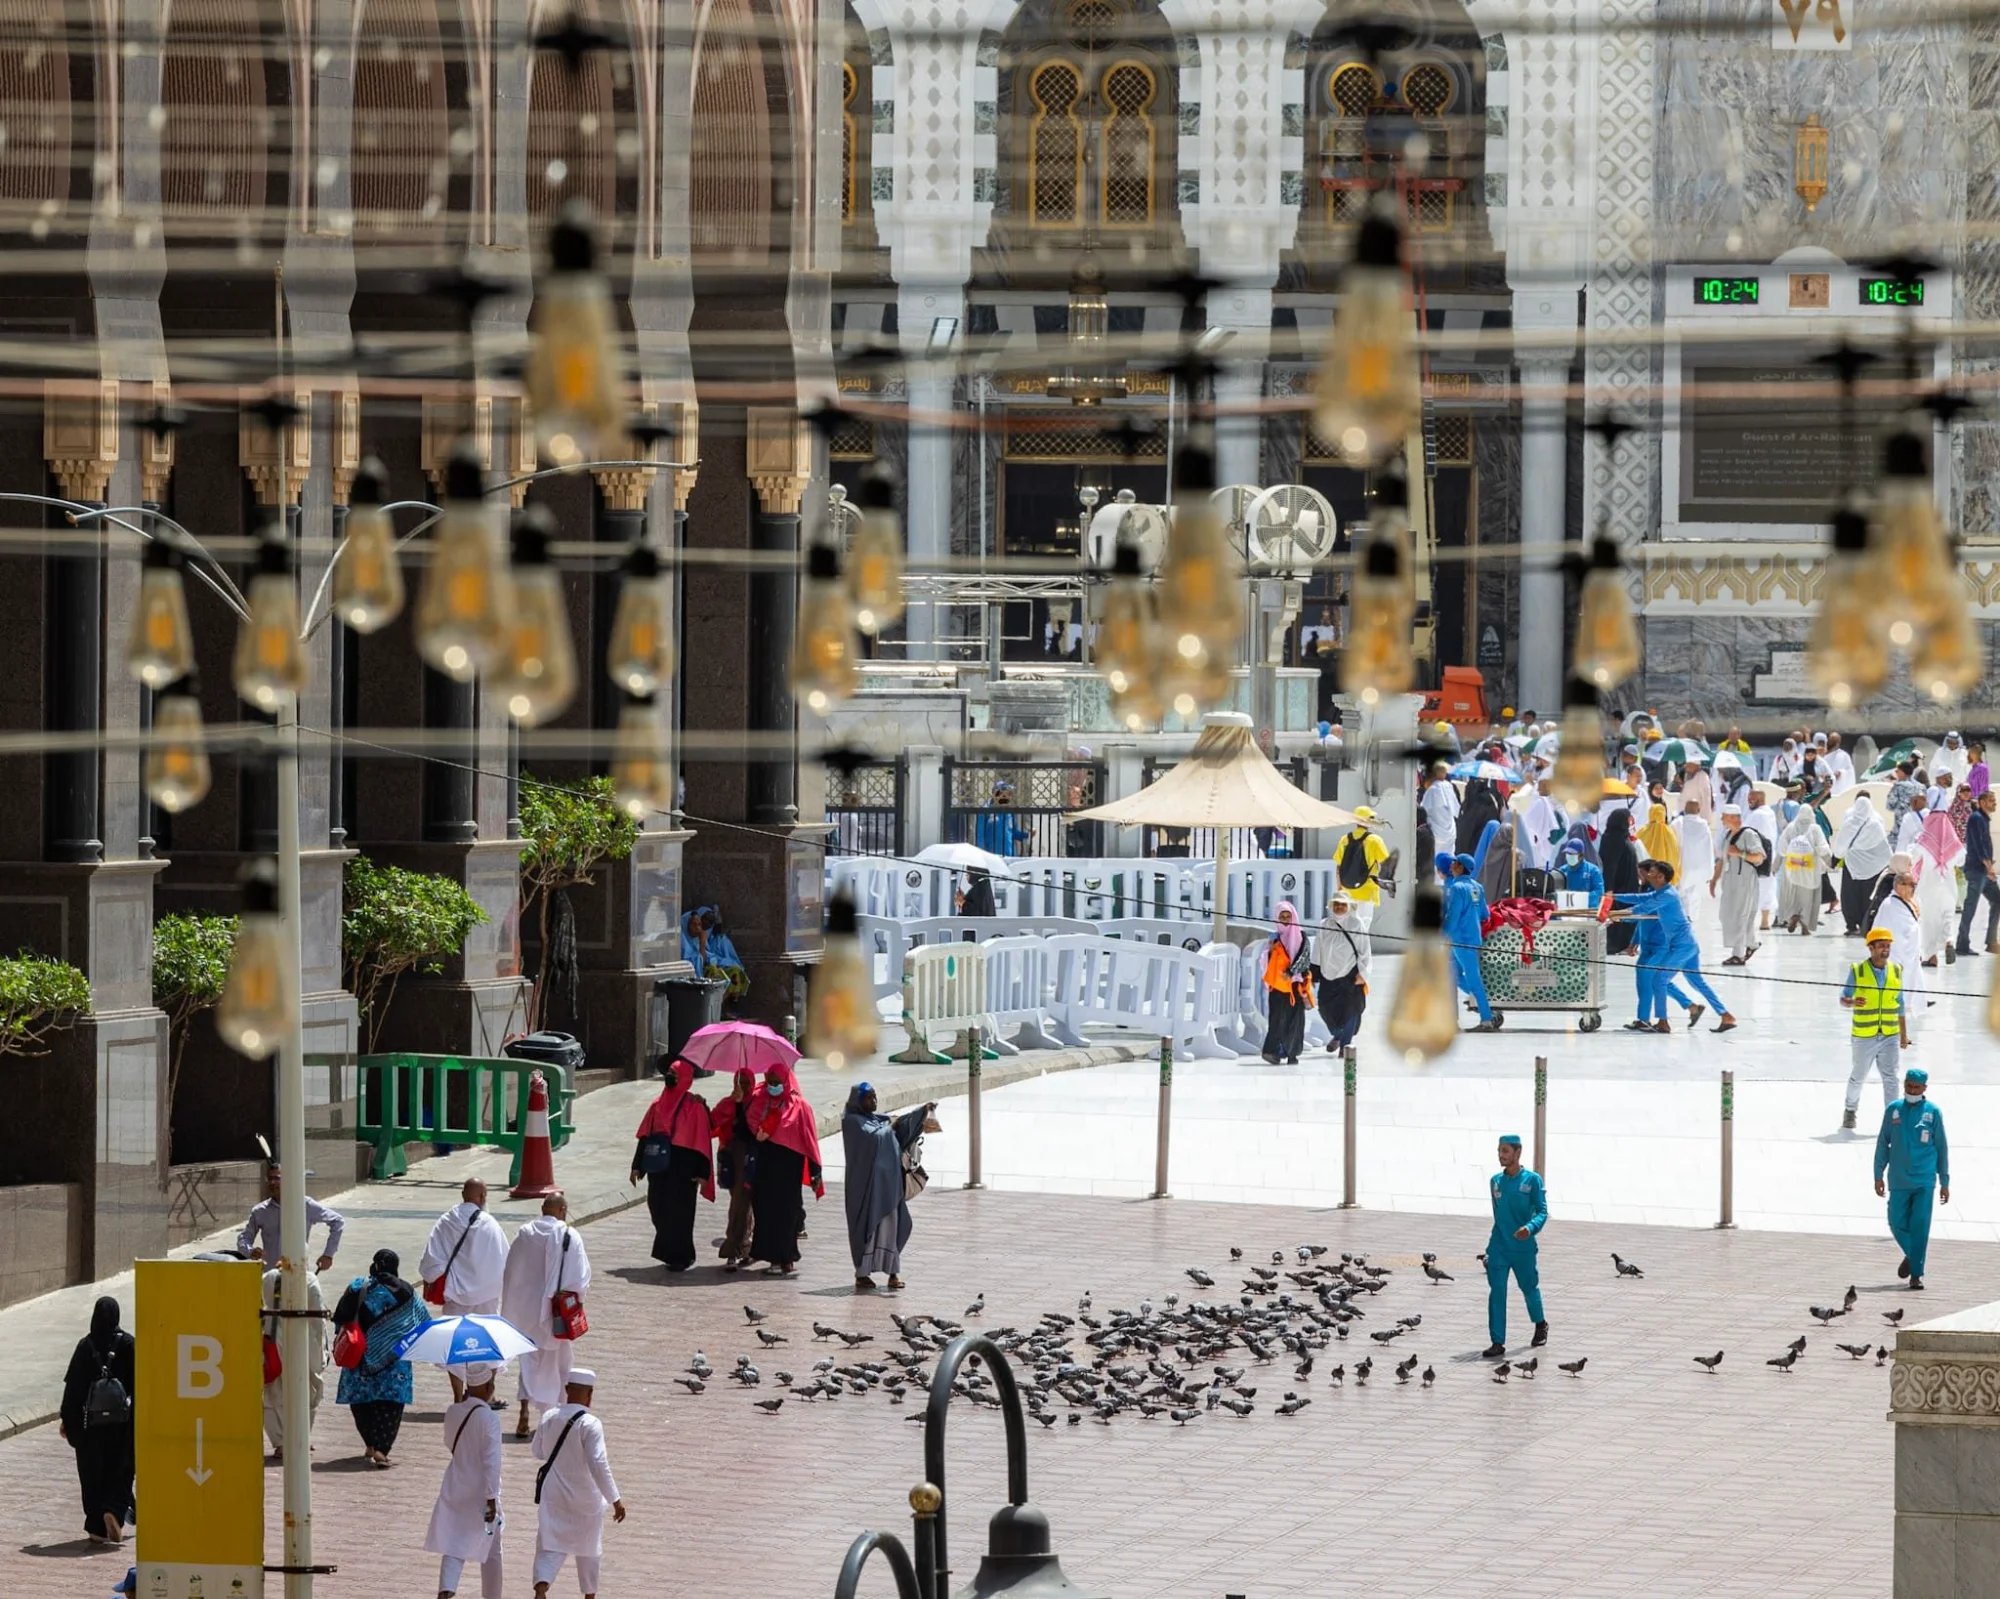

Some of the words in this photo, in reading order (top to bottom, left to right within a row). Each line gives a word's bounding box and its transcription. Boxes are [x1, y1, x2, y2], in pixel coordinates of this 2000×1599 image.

[1703, 280, 1757, 301] 10:24
[1741, 432, 1779, 442] Guest
[1782, 432, 1796, 442] of
[177, 1334, 224, 1398] B
